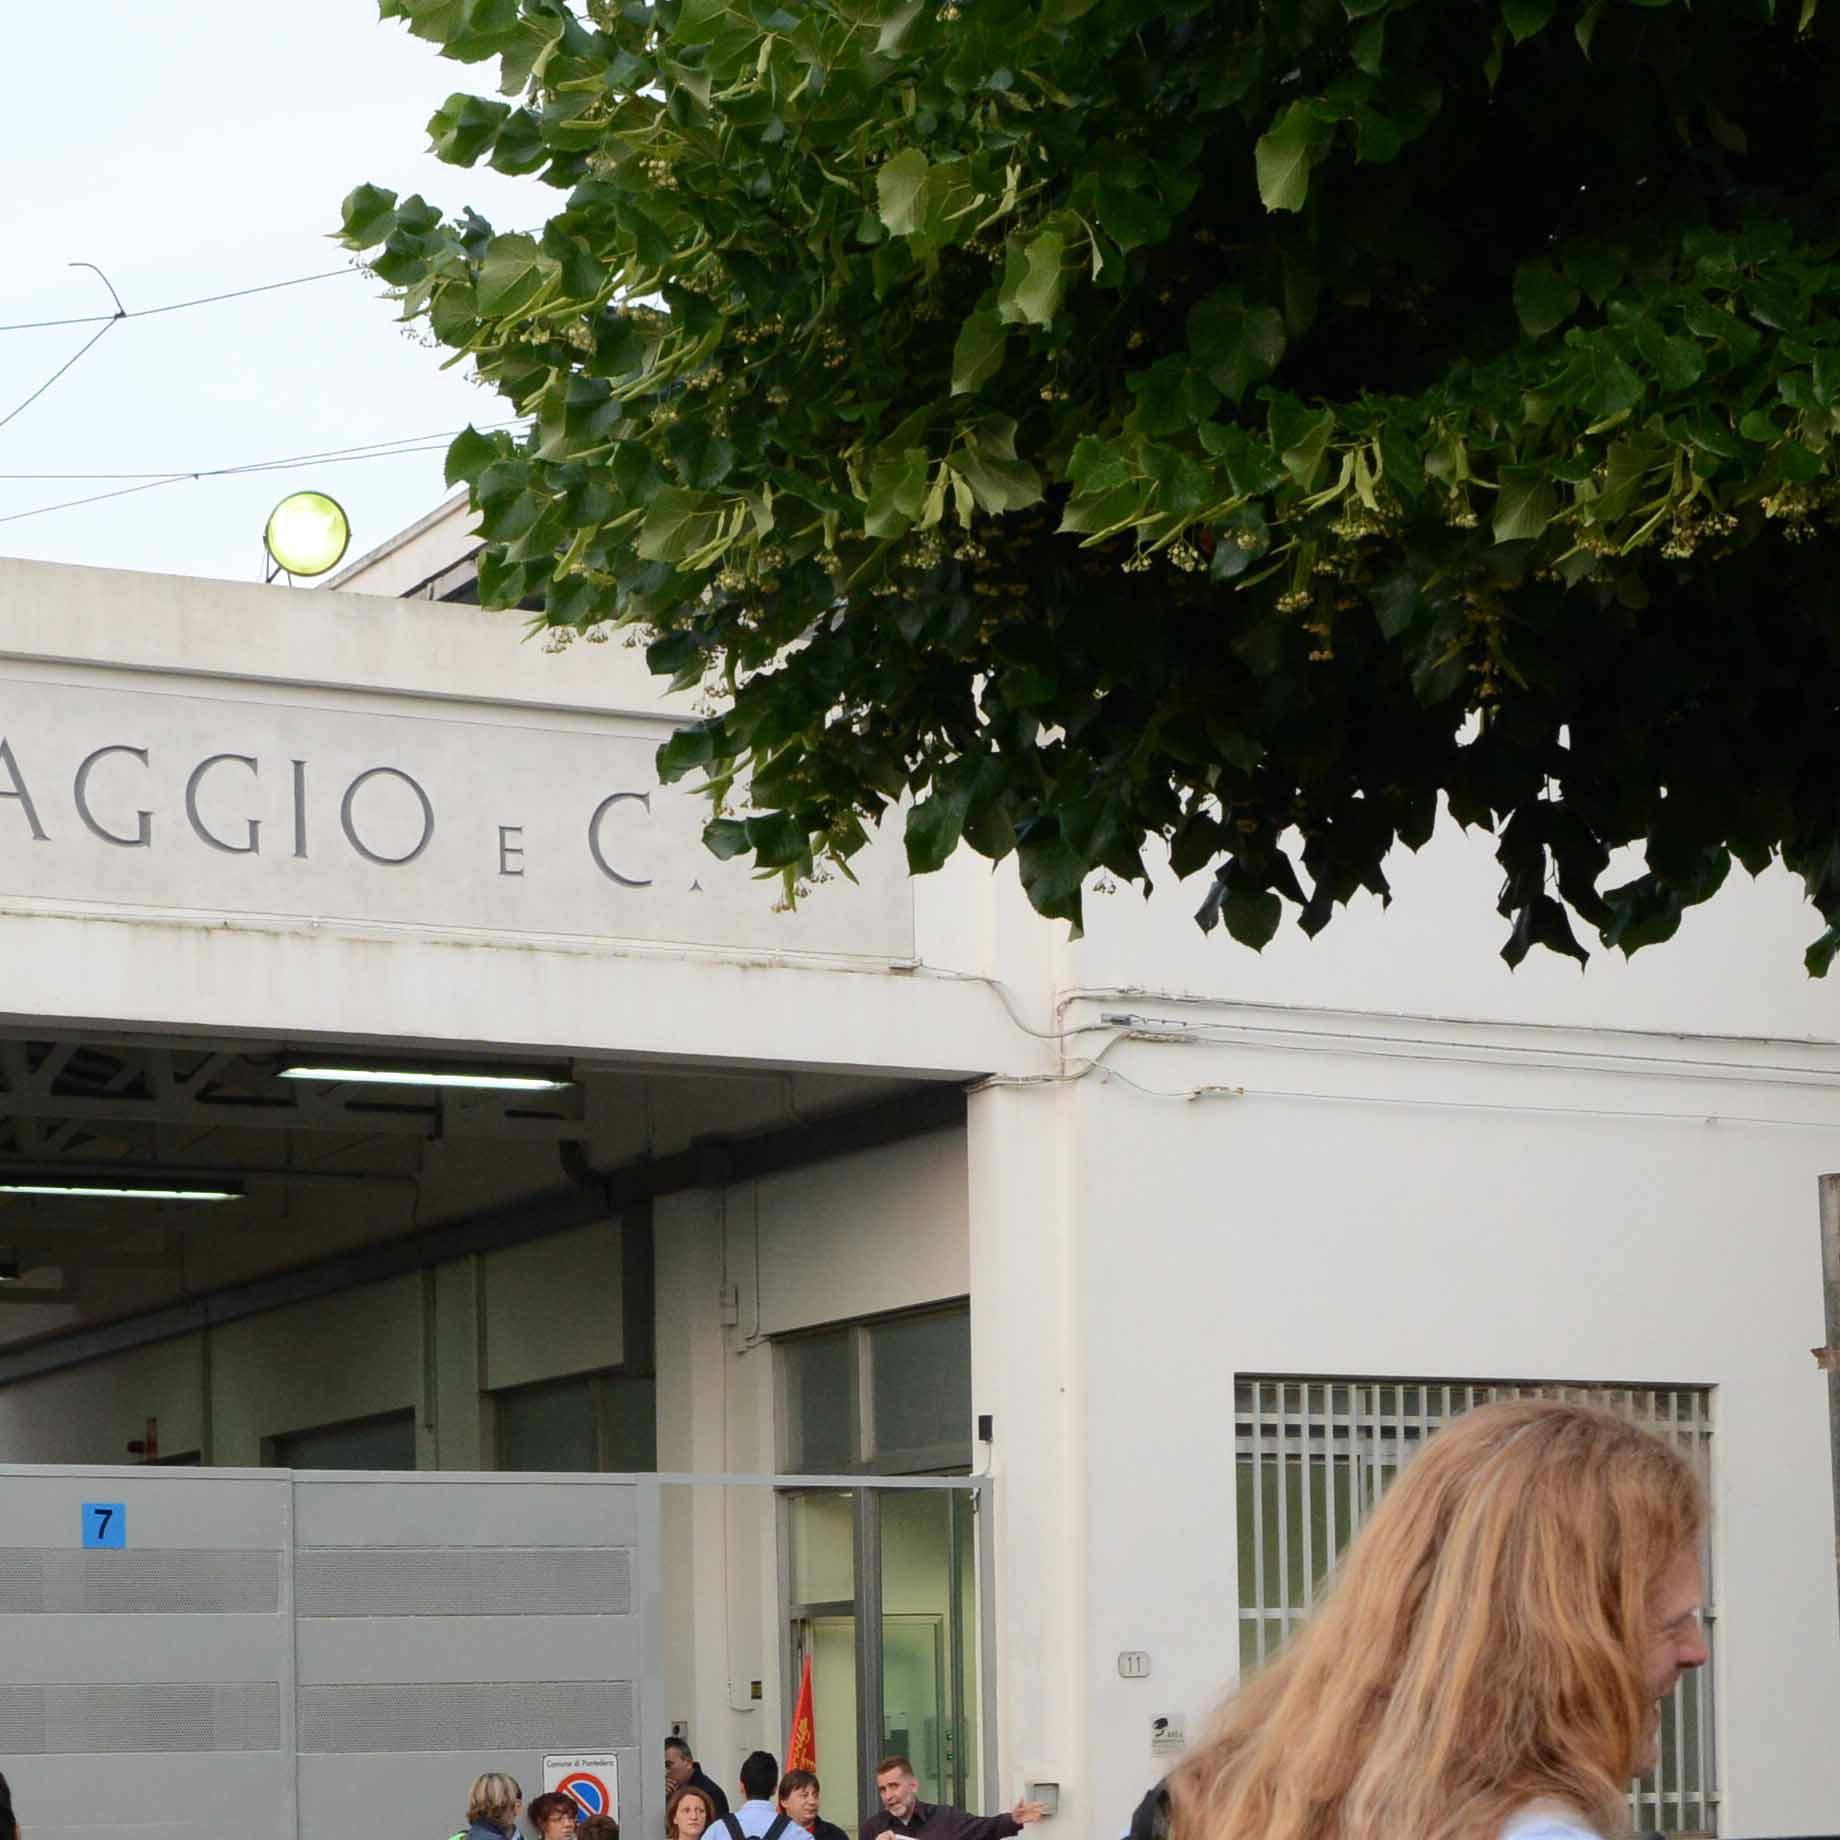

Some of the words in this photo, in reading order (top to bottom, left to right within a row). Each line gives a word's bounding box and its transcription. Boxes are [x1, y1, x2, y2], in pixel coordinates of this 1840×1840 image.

[497, 825, 525, 877] E
[94, 1508, 113, 1540] 7
[1127, 1655, 1141, 1673] 11
